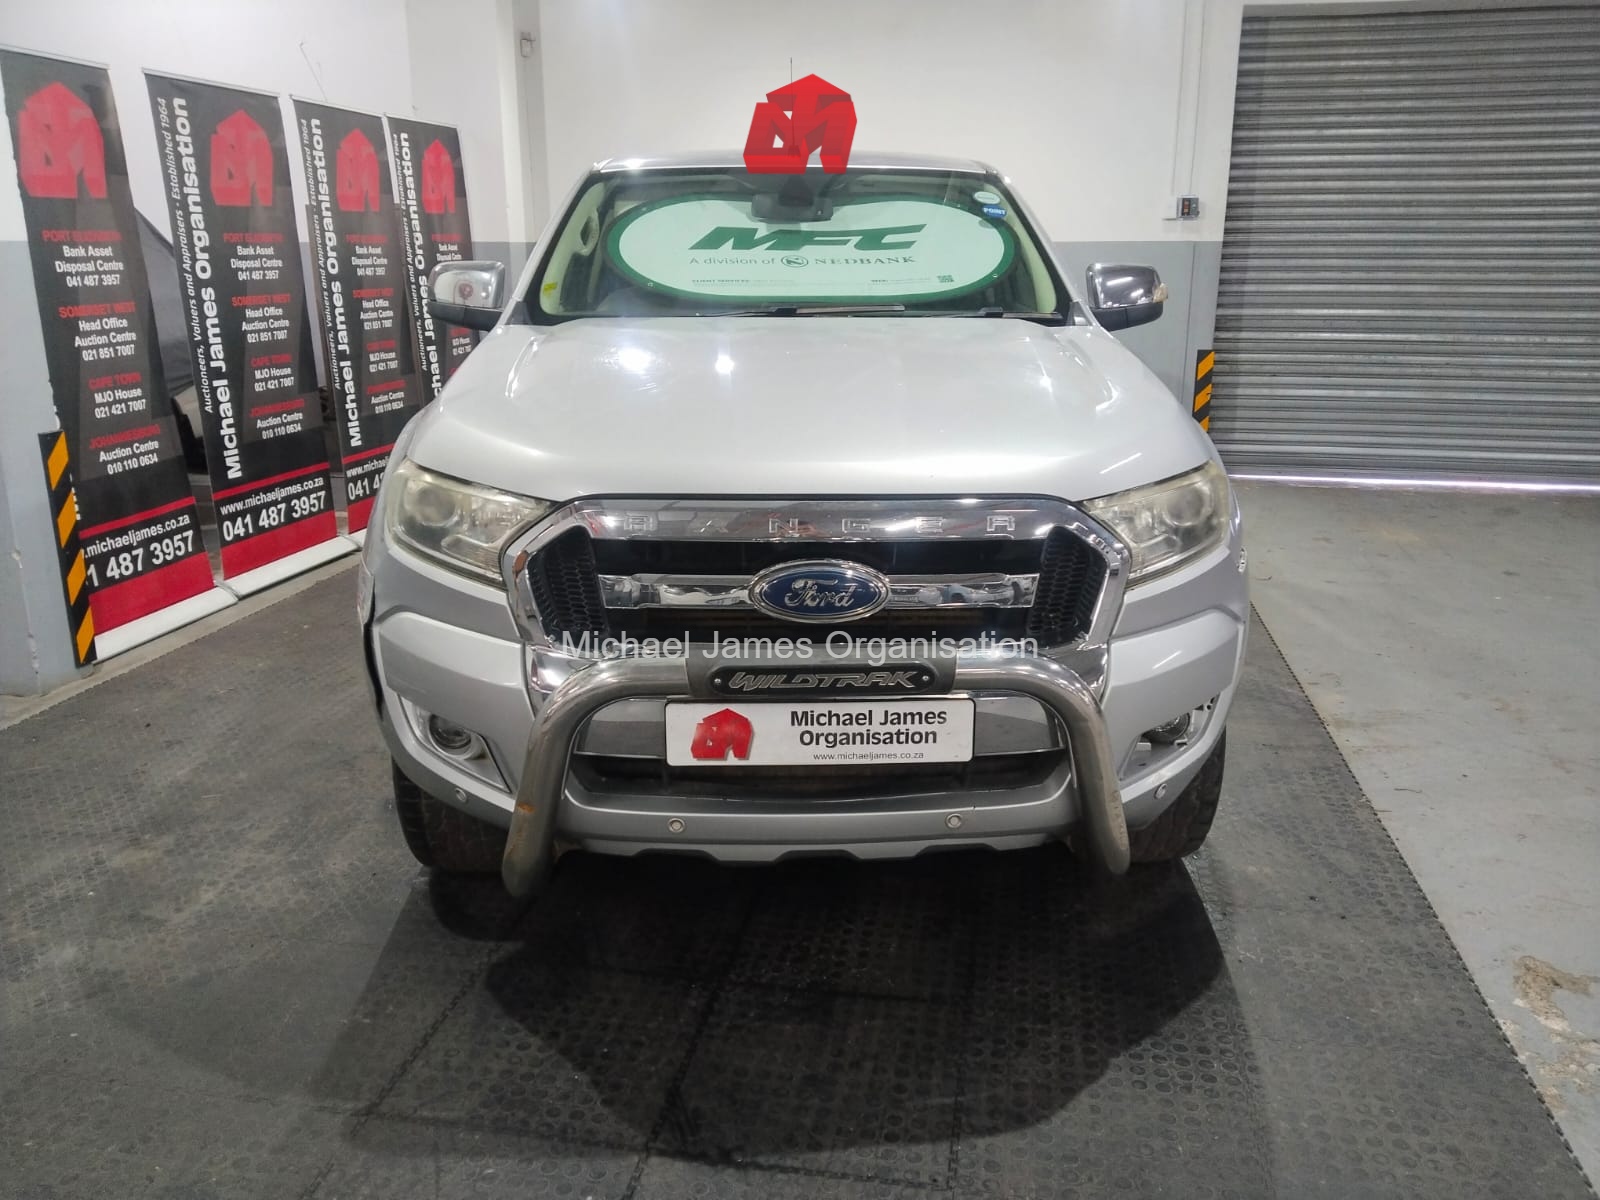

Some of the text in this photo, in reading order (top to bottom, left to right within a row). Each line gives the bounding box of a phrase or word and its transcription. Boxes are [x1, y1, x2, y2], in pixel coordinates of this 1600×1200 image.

[157, 97, 170, 128] 1964
[161, 130, 180, 200] Established
[400, 132, 425, 270] Organisation
[175, 209, 192, 273] Appraisers
[688, 223, 927, 251] MFC
[62, 245, 113, 257] Bank Asset
[236, 245, 255, 256] Bank
[689, 256, 915, 265] A division of NEDBANK
[55, 259, 124, 274] Disposal Centre
[230, 258, 262, 270] Disposal
[66, 274, 120, 287] 041 487 3957
[183, 273, 195, 297] and
[237, 270, 250, 281] 041
[310, 118, 362, 447] Michael James Organisation
[173, 97, 242, 480] Michael James Organisation
[189, 298, 202, 341] Valuers
[263, 306, 283, 317] Office
[78, 317, 128, 331] Head Office
[241, 320, 268, 331] Auction
[75, 331, 137, 347] Auction Centre
[82, 348, 98, 361] 021
[99, 347, 115, 359] 851
[196, 345, 213, 413] Auctioneers,
[426, 345, 442, 397] chael
[94, 388, 142, 404] MJO House
[94, 398, 147, 419] 021 421 7007
[256, 416, 282, 429] Auction
[99, 440, 160, 463] Auction Centre
[107, 452, 159, 475] 010 110 0634
[220, 476, 325, 516] www.michaeljames.co.za
[347, 477, 370, 500] 041
[222, 490, 326, 542] 041 487 3957
[84, 514, 191, 559] .michaeljames.co.za
[105, 547, 144, 579] 487
[149, 529, 194, 565] 3957
[784, 578, 859, 607] Ford
[728, 671, 918, 691] WILDTRAK
[790, 709, 948, 727] Michael James
[799, 728, 938, 748] Organisation
[812, 751, 924, 762] www.michaeljames.co.za
